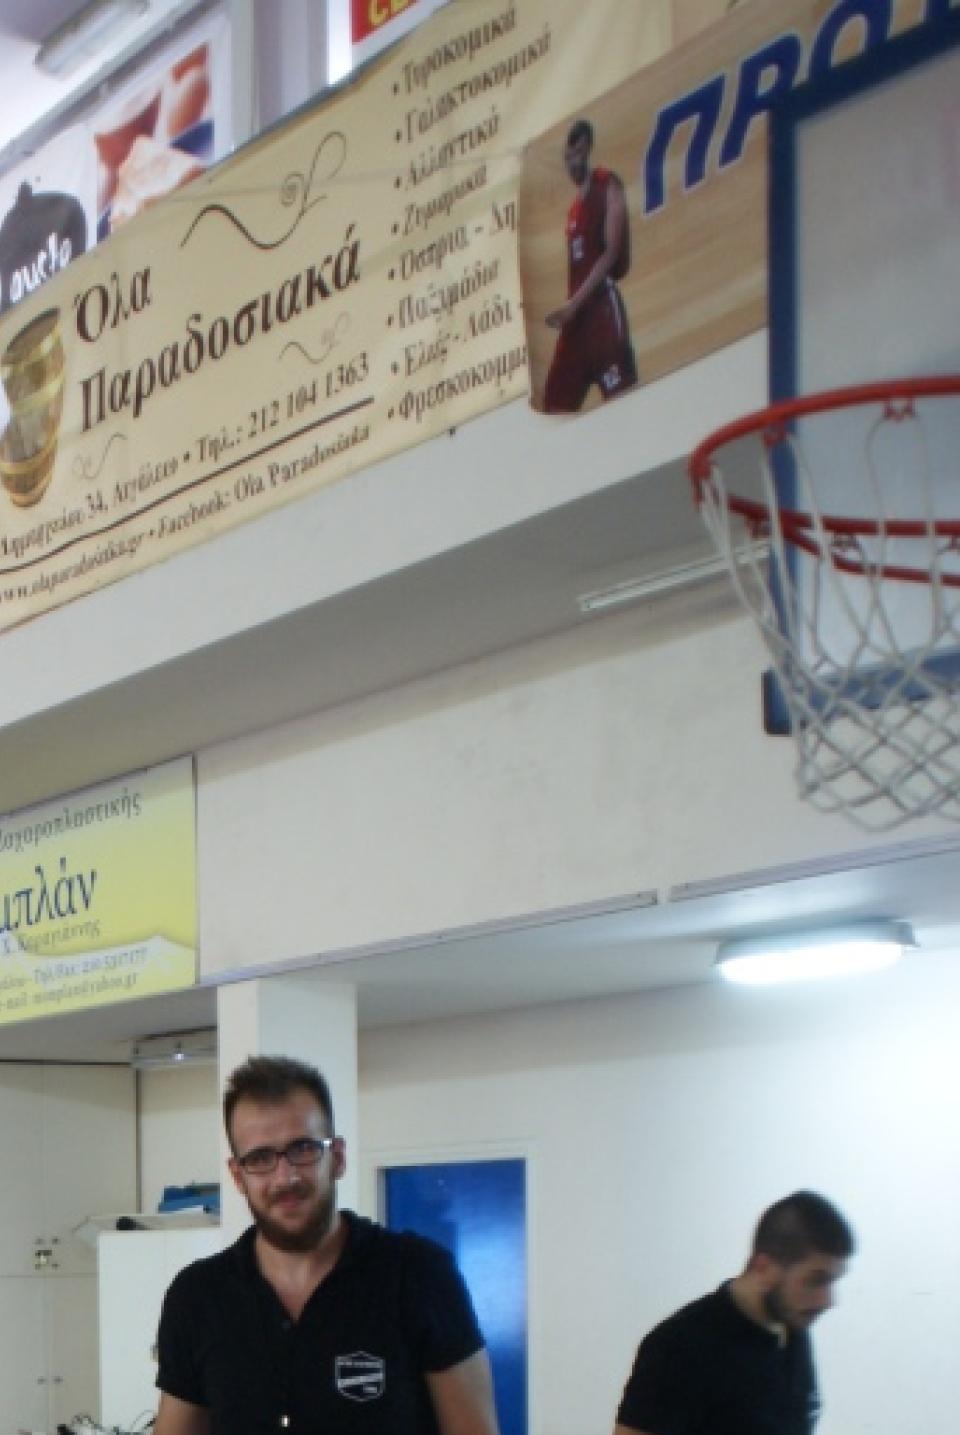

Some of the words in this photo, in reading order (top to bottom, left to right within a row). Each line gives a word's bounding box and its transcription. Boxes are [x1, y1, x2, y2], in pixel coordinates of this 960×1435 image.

[74, 266, 151, 342] Όλα
[80, 222, 360, 432] Παραδοσιακά
[248, 400, 279, 438] 212
